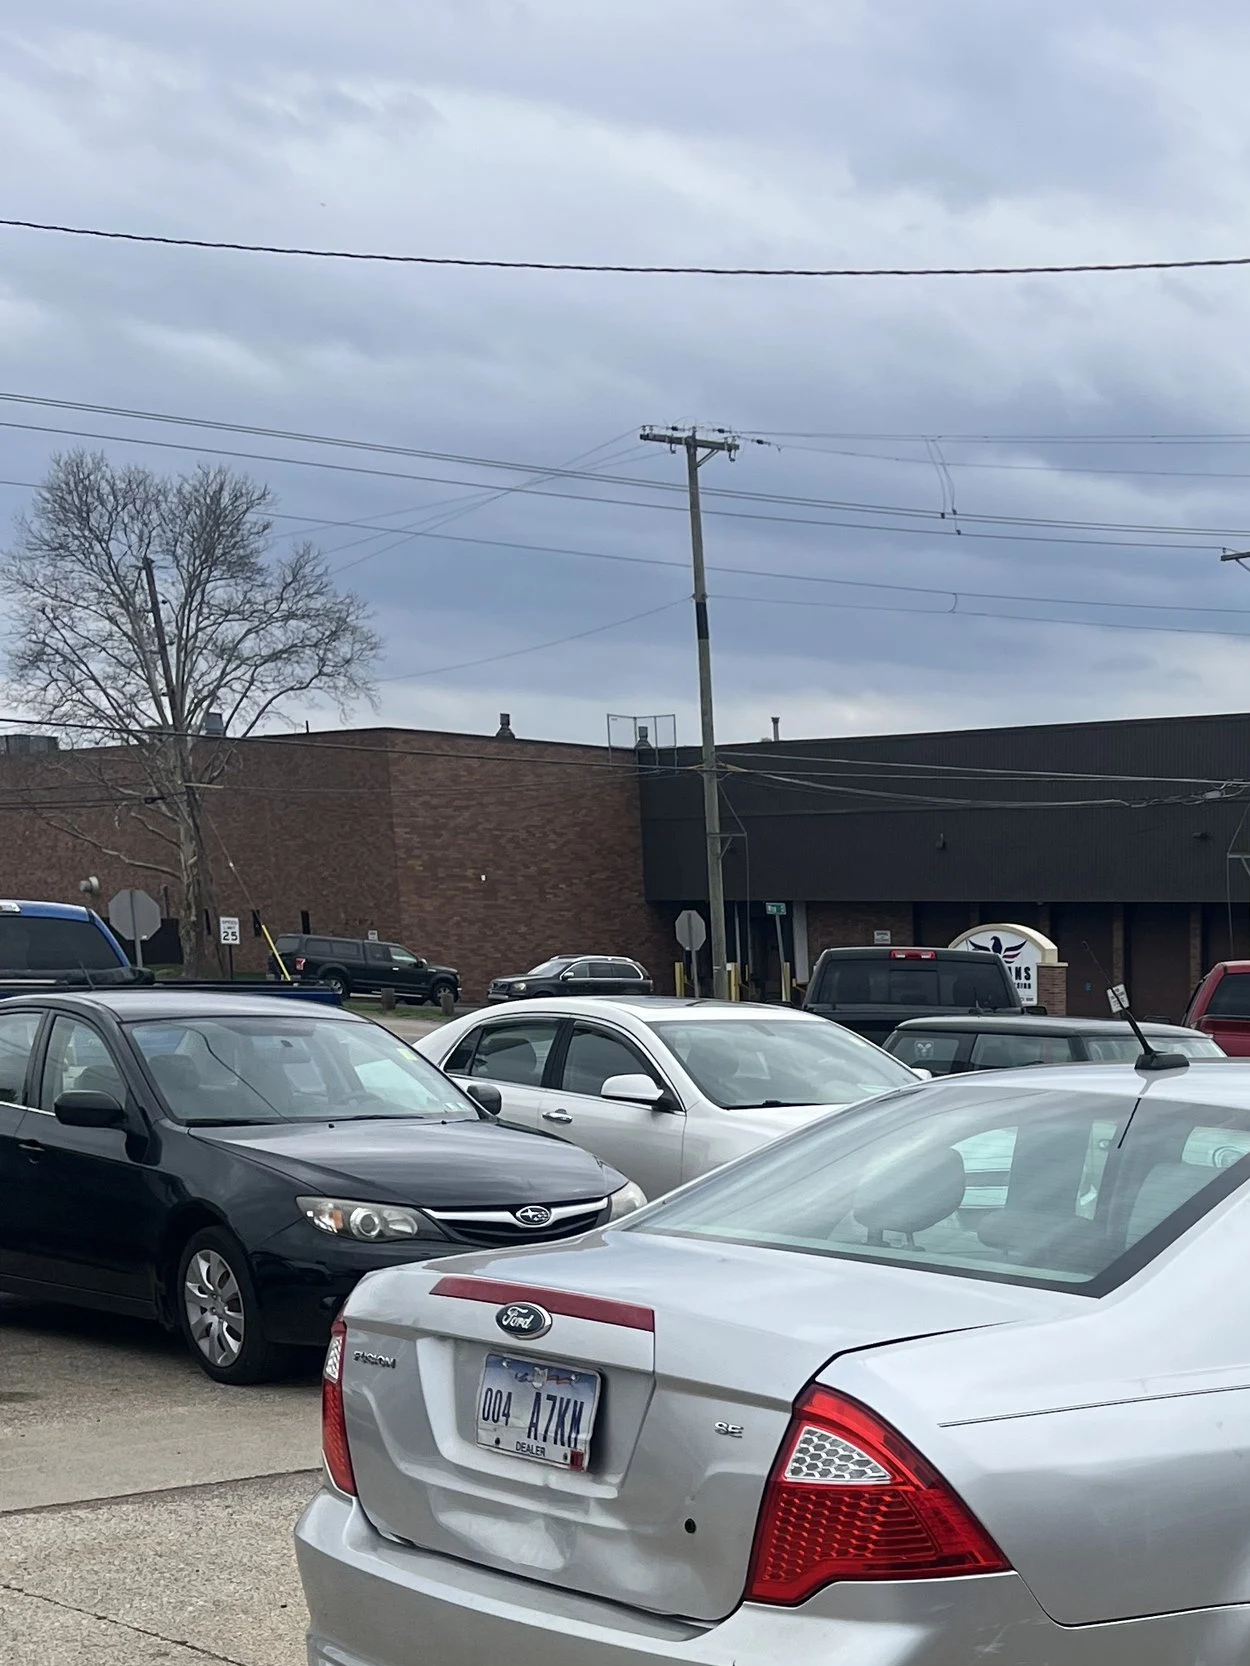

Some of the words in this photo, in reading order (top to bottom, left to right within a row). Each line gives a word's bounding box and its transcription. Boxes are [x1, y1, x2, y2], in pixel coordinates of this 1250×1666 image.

[222, 930, 238, 941] 25
[502, 1306, 535, 1329] Ford
[353, 1350, 397, 1369] FUSION
[482, 1387, 513, 1427] 004
[713, 1421, 744, 1438] SE
[515, 1441, 546, 1457] DEALER
